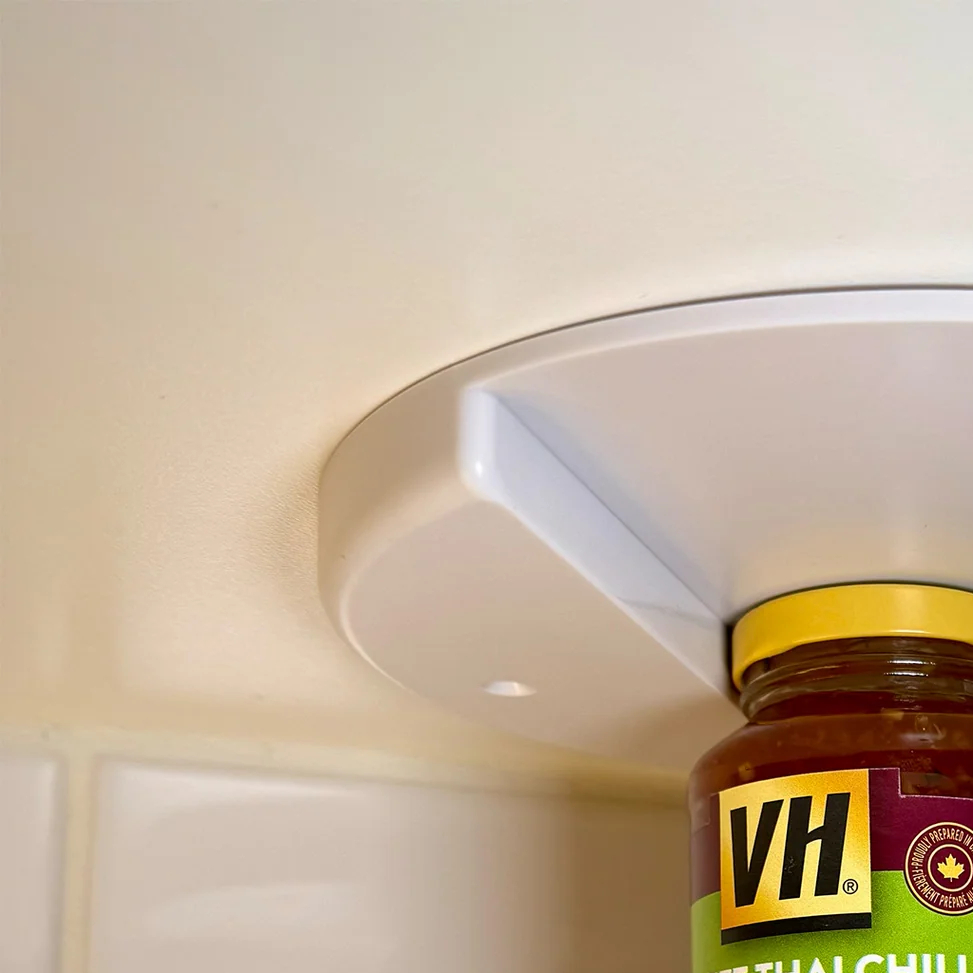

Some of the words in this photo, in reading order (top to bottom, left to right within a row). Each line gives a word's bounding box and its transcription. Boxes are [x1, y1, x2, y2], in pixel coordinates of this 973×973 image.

[730, 792, 851, 908] VH
[911, 836, 932, 867] PROUDLY
[928, 828, 965, 844] PREPARED
[963, 834, 973, 847] IN
[938, 892, 969, 908] PRÉPARÉ
